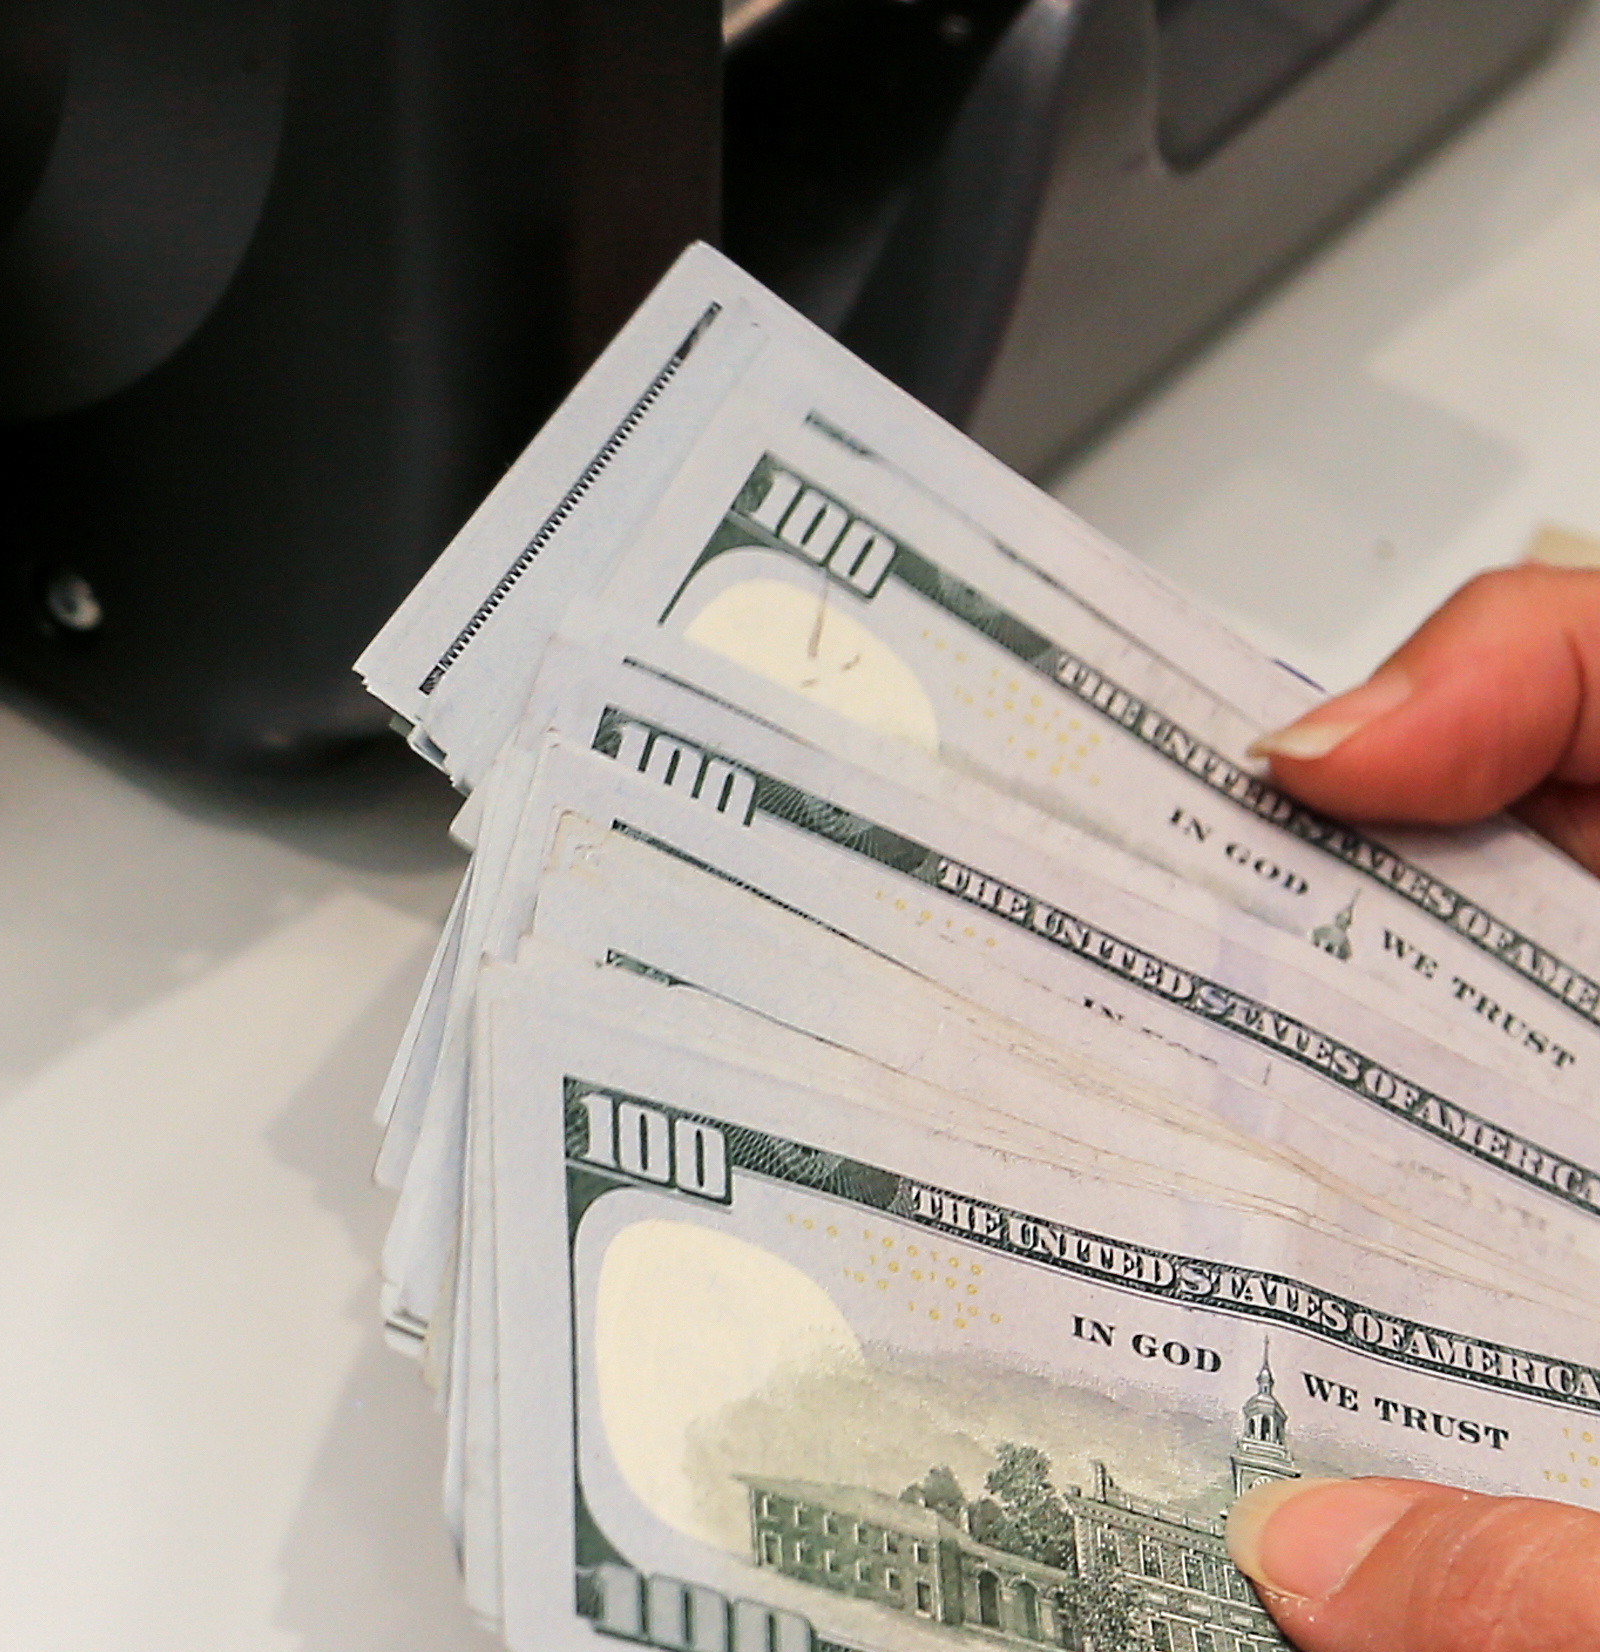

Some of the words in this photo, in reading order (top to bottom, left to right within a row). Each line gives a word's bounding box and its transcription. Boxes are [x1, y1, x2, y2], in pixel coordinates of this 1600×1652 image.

[750, 468, 898, 599] 100
[1055, 652, 1142, 728] THE
[938, 857, 1031, 921] THE
[1030, 904, 1197, 1001] UNITED
[1195, 983, 1363, 1082] STATES
[1362, 1067, 1421, 1109] OF
[1169, 806, 1212, 843] IN
[1225, 842, 1309, 897] GOD
[1381, 927, 1439, 980] WE
[1451, 976, 1577, 1071] TRUST
[577, 1092, 732, 1203] 100
[909, 1185, 1000, 1238] THE
[1003, 1215, 1174, 1289] UNITED
[1175, 1262, 1350, 1337] STATES
[1351, 1310, 1410, 1349] OF
[1072, 1316, 1116, 1347] IN
[1131, 1333, 1223, 1375] GOD
[1302, 1373, 1360, 1414] WE
[1374, 1396, 1510, 1452] TRUST
